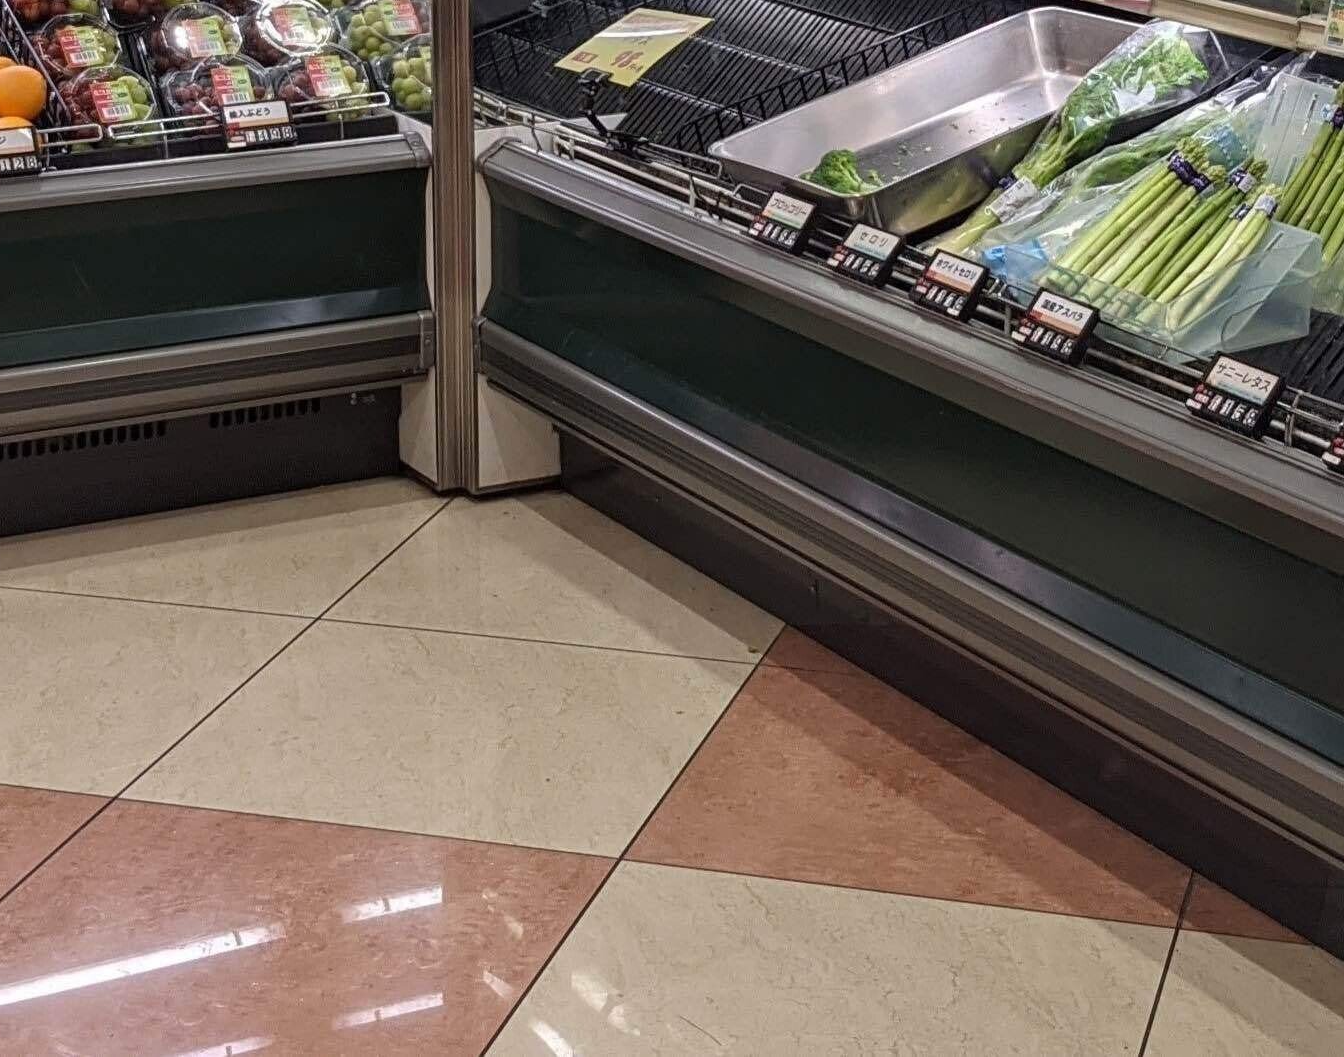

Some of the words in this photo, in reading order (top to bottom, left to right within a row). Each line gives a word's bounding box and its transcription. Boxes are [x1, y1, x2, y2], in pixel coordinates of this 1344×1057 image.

[860, 230, 890, 248] セロリ
[1216, 361, 1273, 393] サニーレタス
